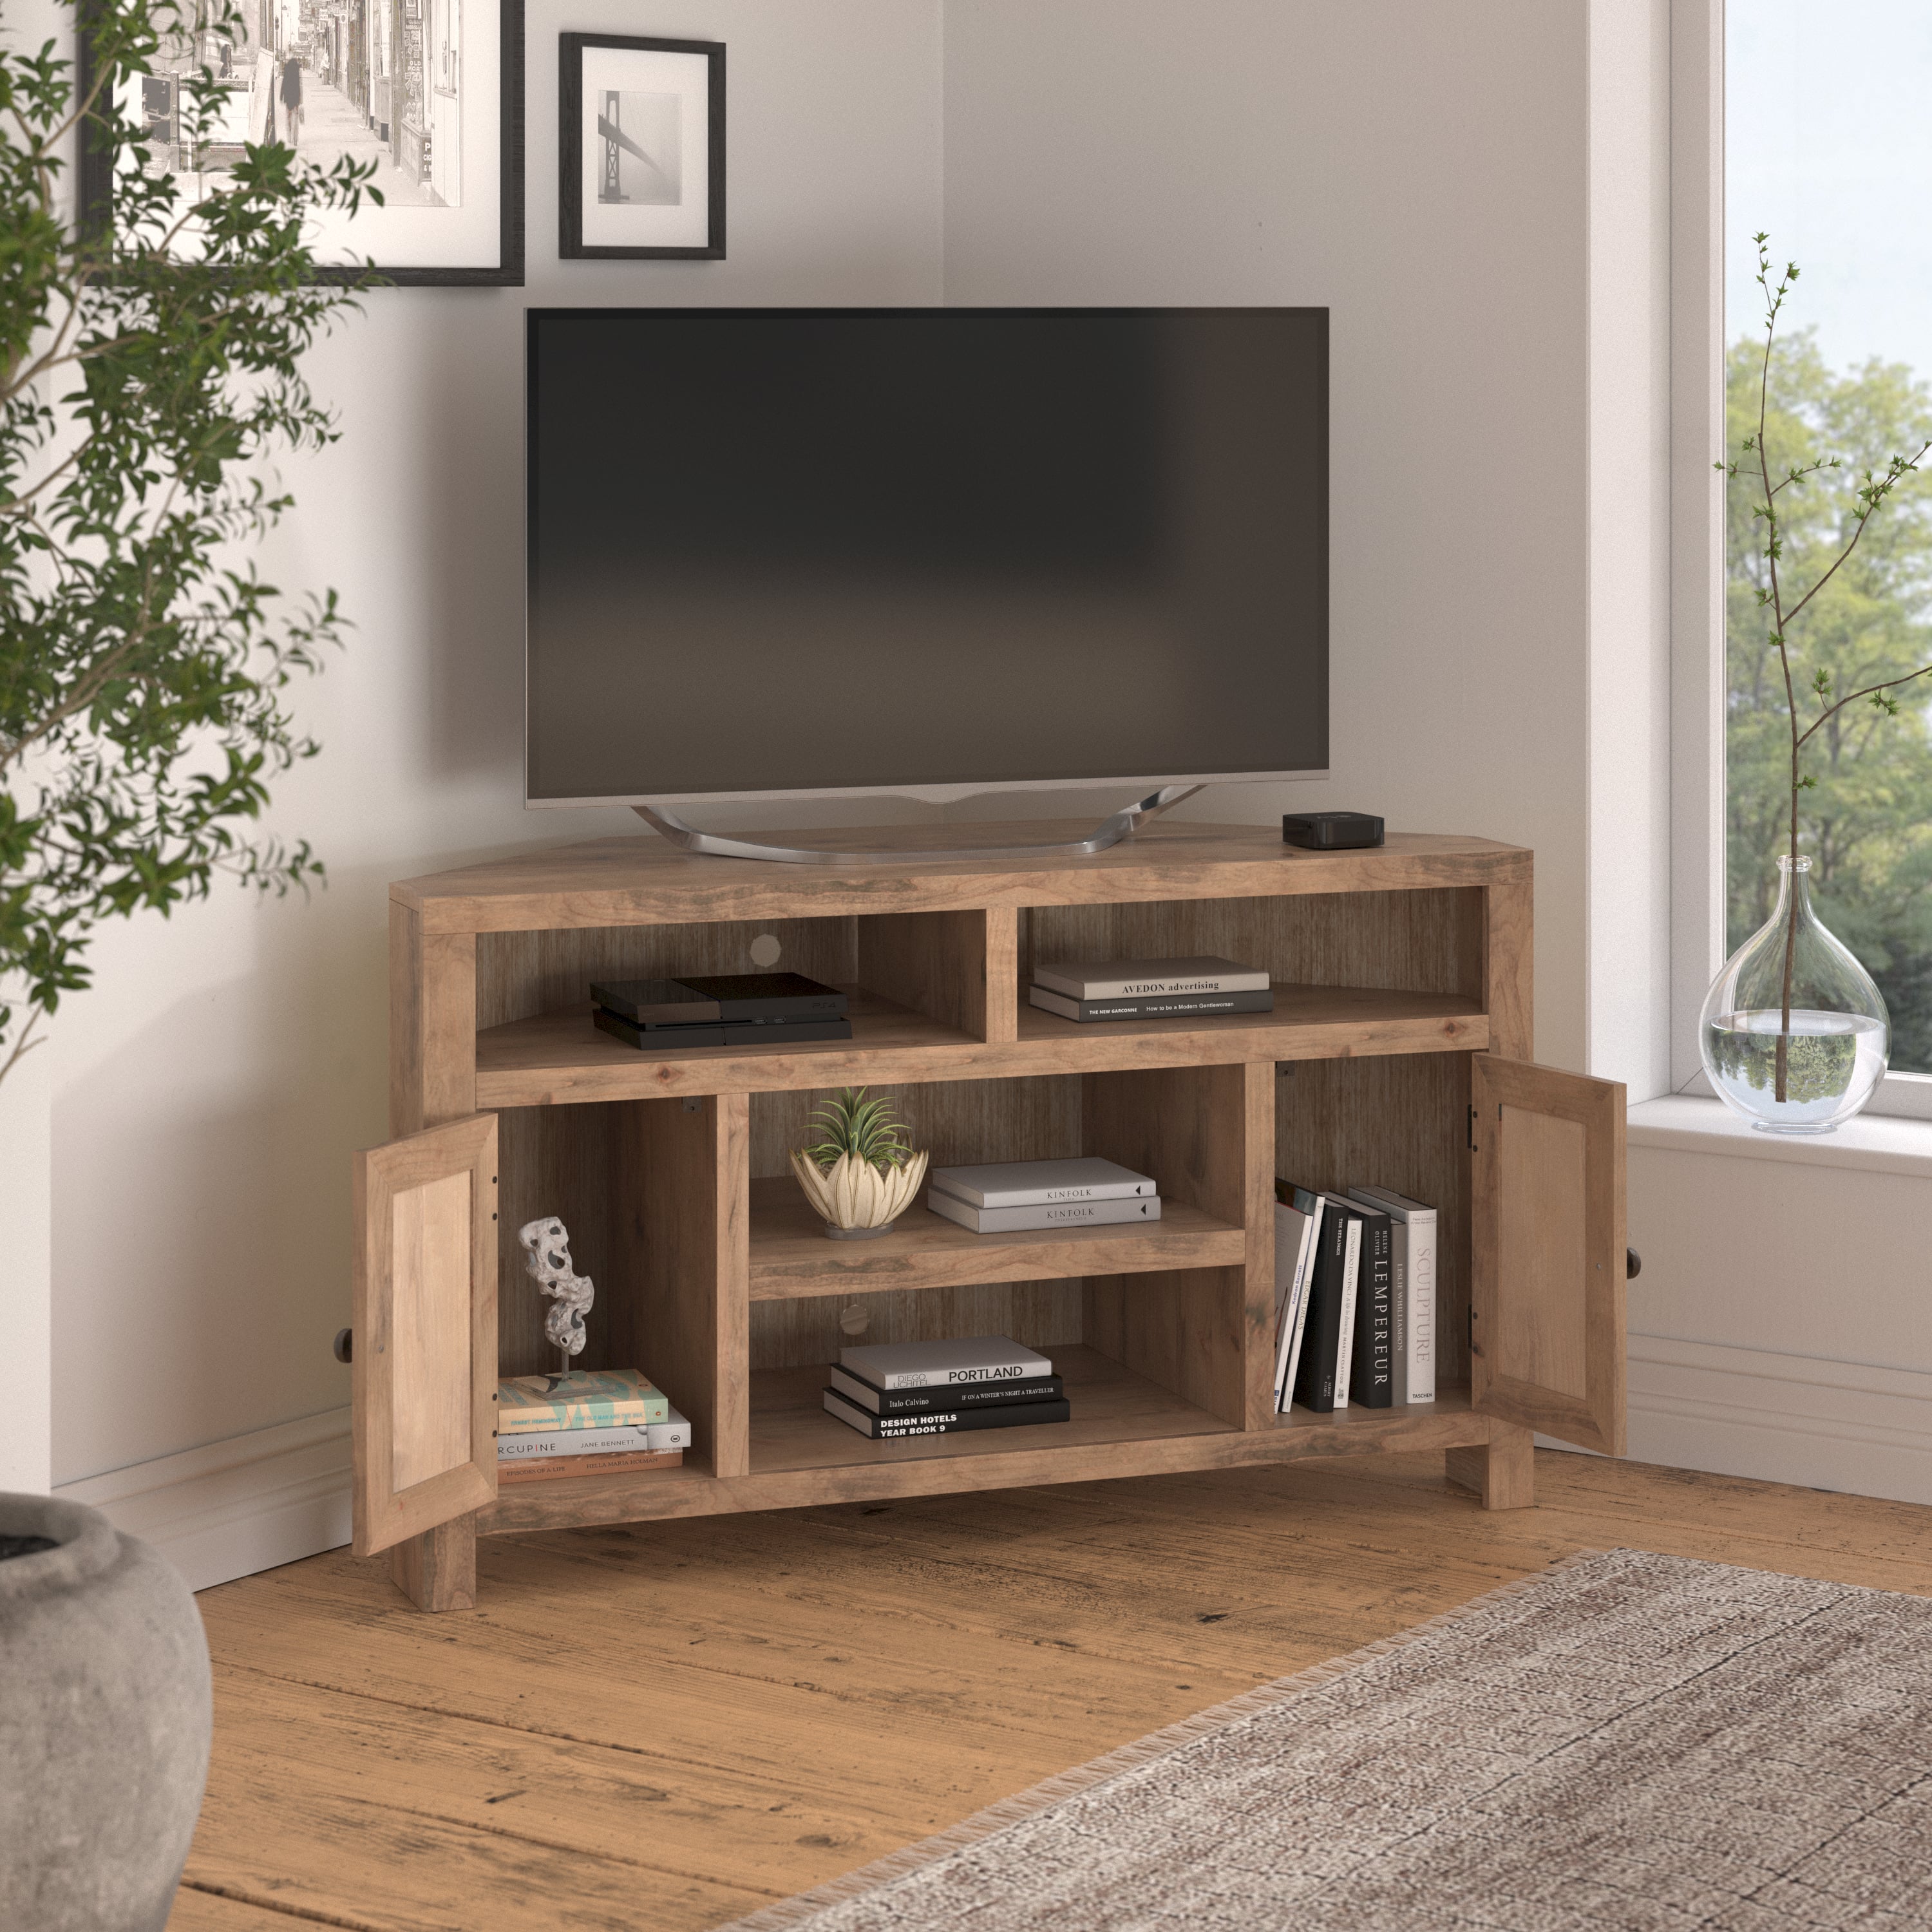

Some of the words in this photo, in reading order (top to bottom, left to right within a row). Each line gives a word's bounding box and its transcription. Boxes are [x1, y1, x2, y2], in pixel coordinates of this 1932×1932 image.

[424, 142, 431, 151] P
[1122, 983, 1165, 994] AVEDON
[1168, 981, 1219, 991] advertising
[1047, 1189, 1092, 1198] KINFOLK
[1047, 1208, 1094, 1218] KINFOLK
[1348, 1267, 1353, 1276] DA
[1302, 1281, 1311, 1307] EDGAR
[1417, 1248, 1431, 1363] SCULPTURE
[1298, 1307, 1307, 1331] DEGAS
[1374, 1260, 1388, 1385] LEMPEREUR
[898, 1374, 926, 1382] DIEGO
[949, 1366, 1023, 1382] PORTLAND
[893, 1380, 931, 1388] UCHITEL
[881, 1418, 917, 1428] DESIGN
[920, 1414, 957, 1424] HOTELS
[880, 1429, 906, 1437] YEAR
[909, 1426, 936, 1434] BOOK
